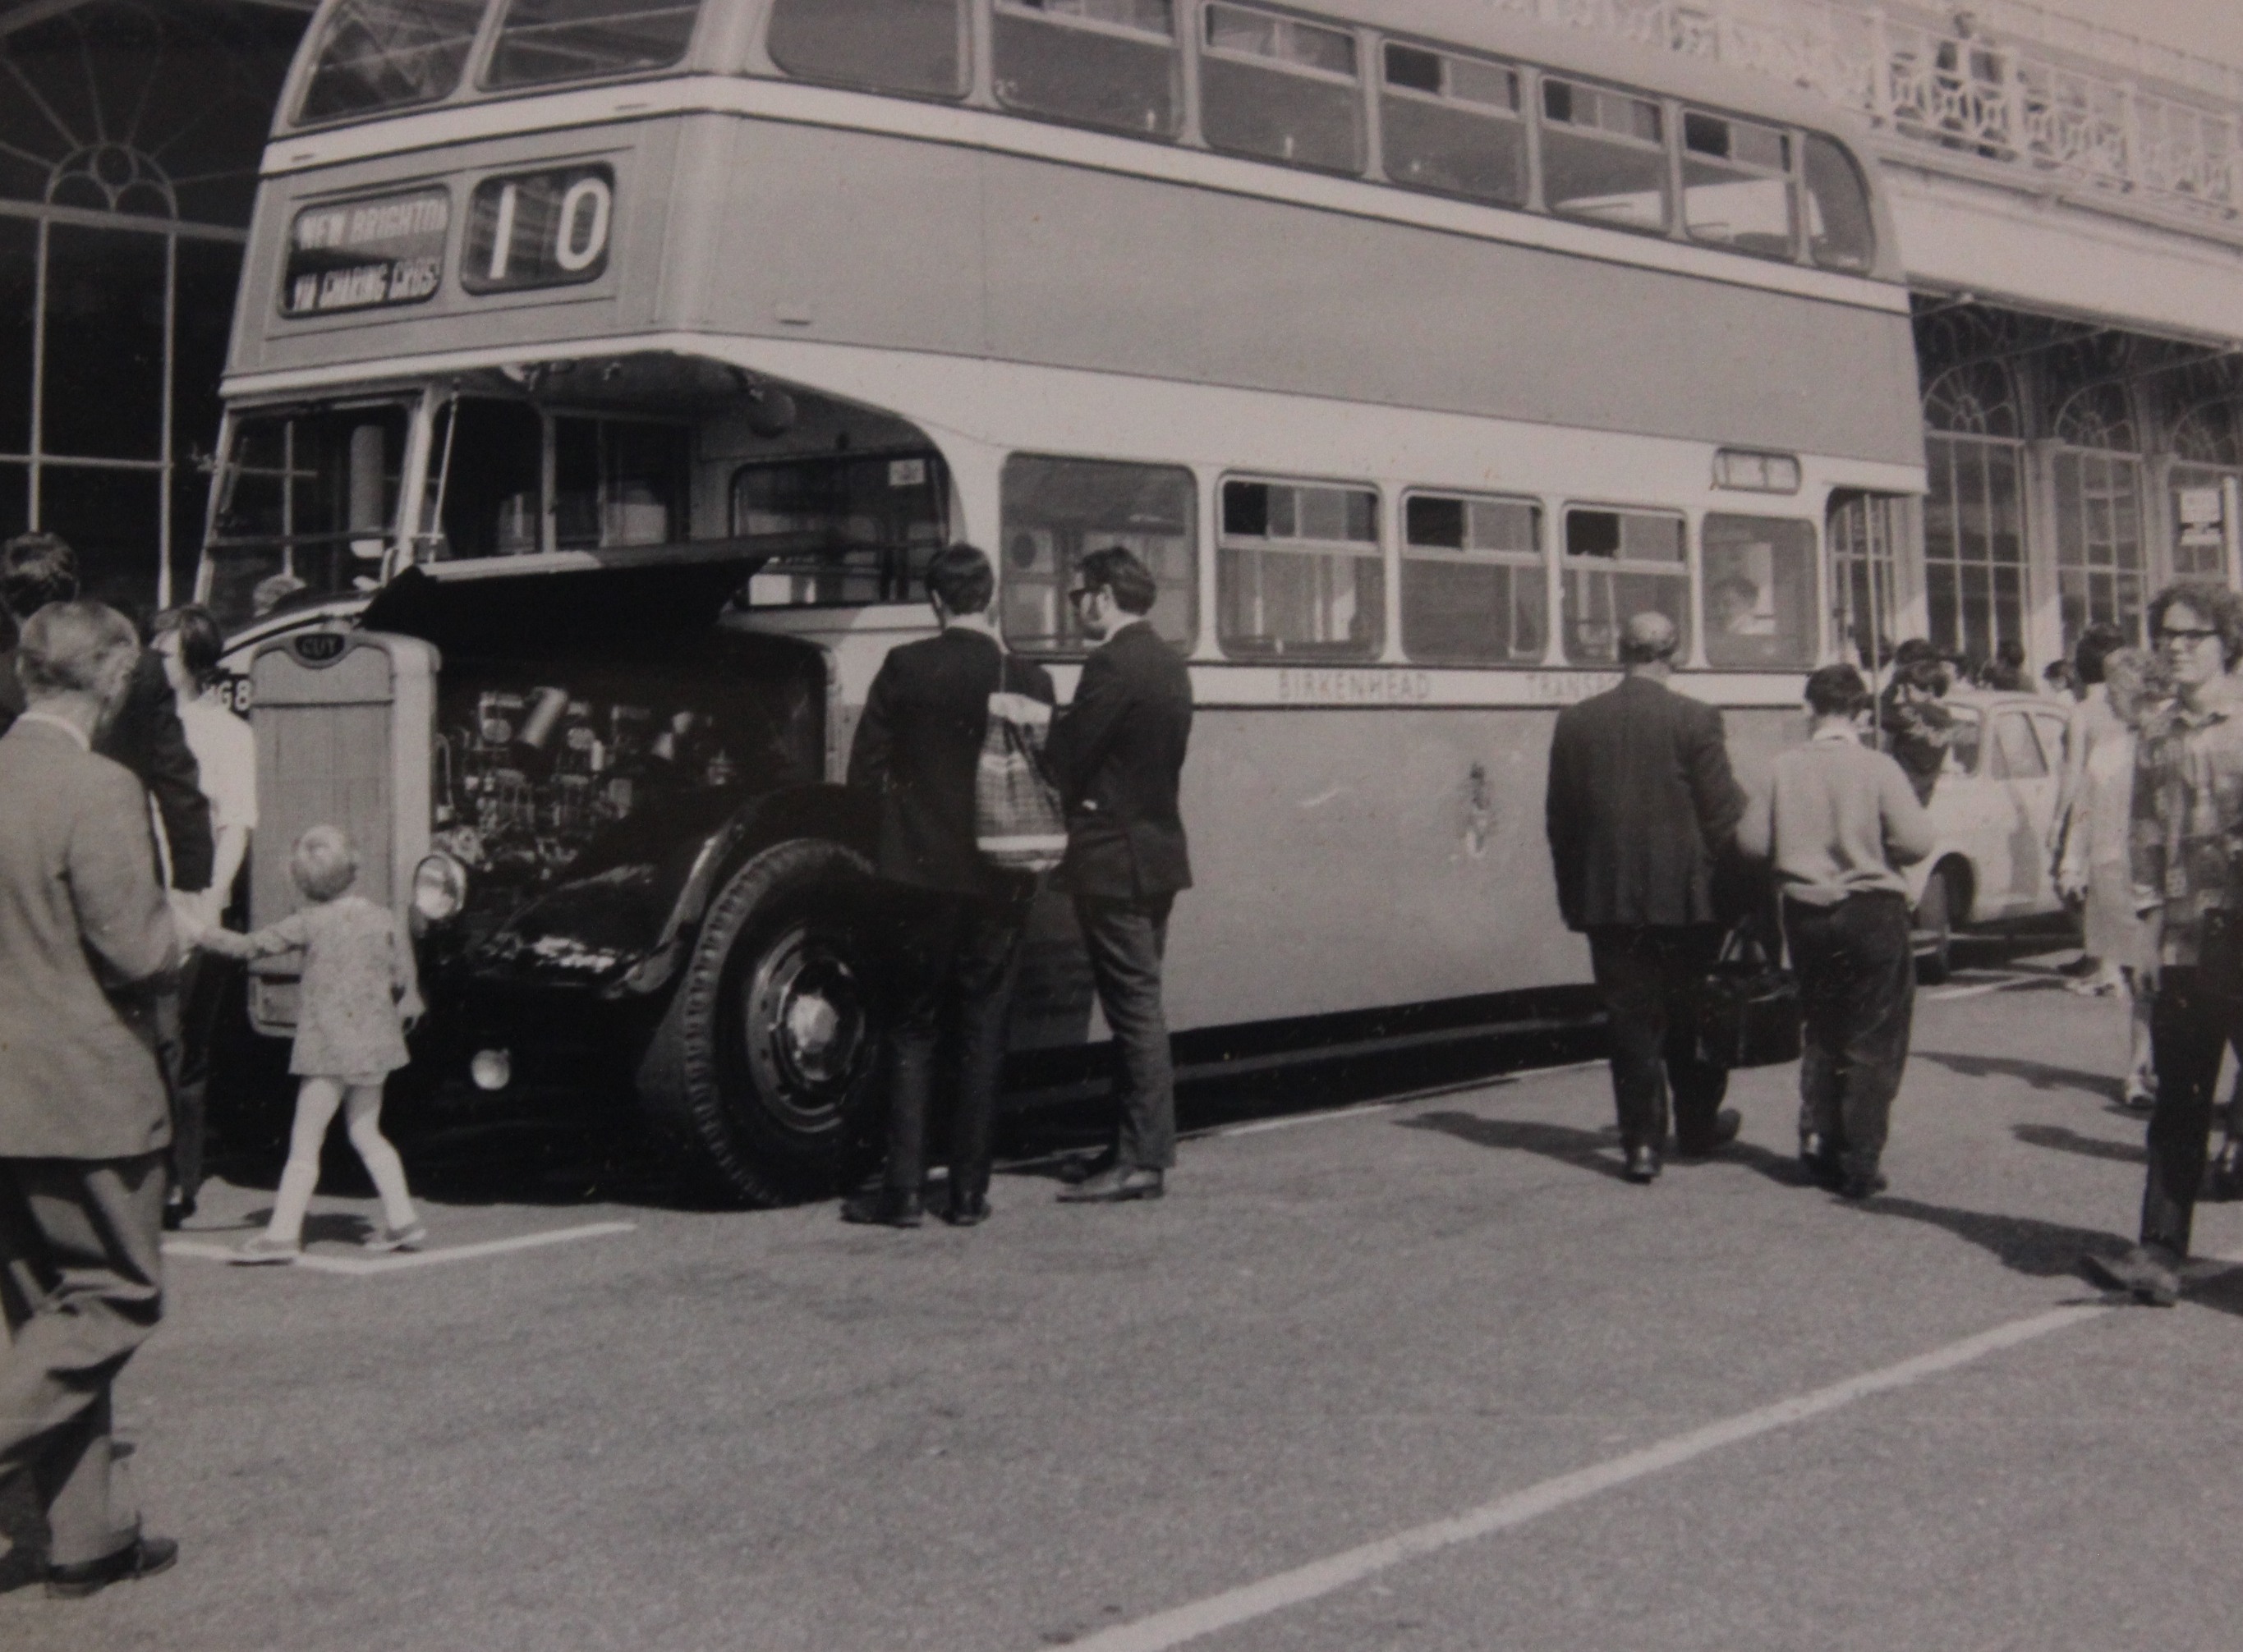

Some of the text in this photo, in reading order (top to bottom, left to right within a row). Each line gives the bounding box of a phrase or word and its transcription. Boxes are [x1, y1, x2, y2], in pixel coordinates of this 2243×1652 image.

[489, 177, 610, 279] 10
[301, 636, 338, 656] GUY
[1279, 668, 1430, 700] BIRKENHEAD
